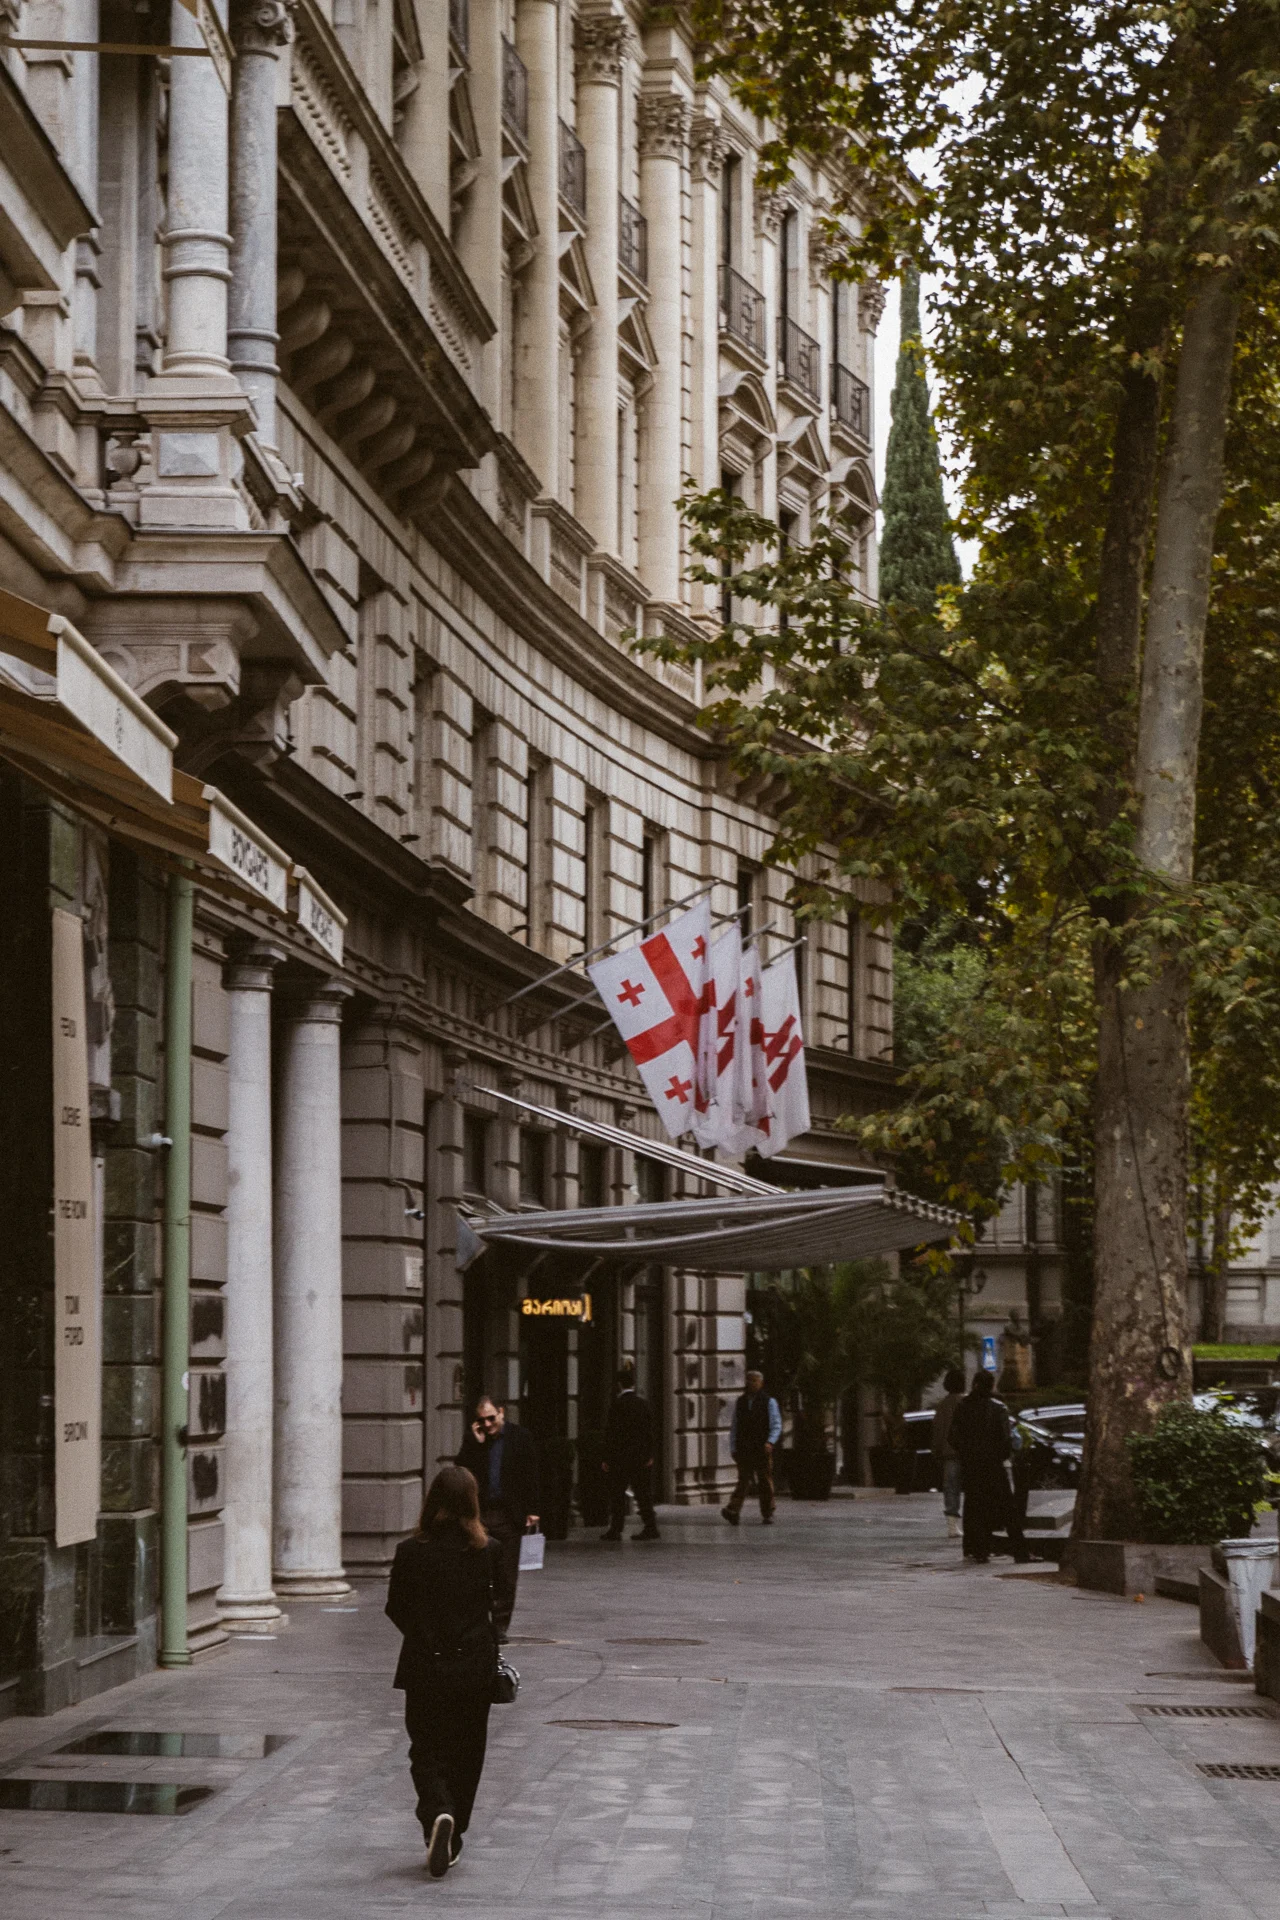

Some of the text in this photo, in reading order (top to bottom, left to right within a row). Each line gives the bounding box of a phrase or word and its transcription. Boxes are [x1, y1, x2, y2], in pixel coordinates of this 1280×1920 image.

[58, 1199, 71, 1219] THE
[64, 1295, 80, 1315] TOM
[64, 1326, 84, 1347] FORD
